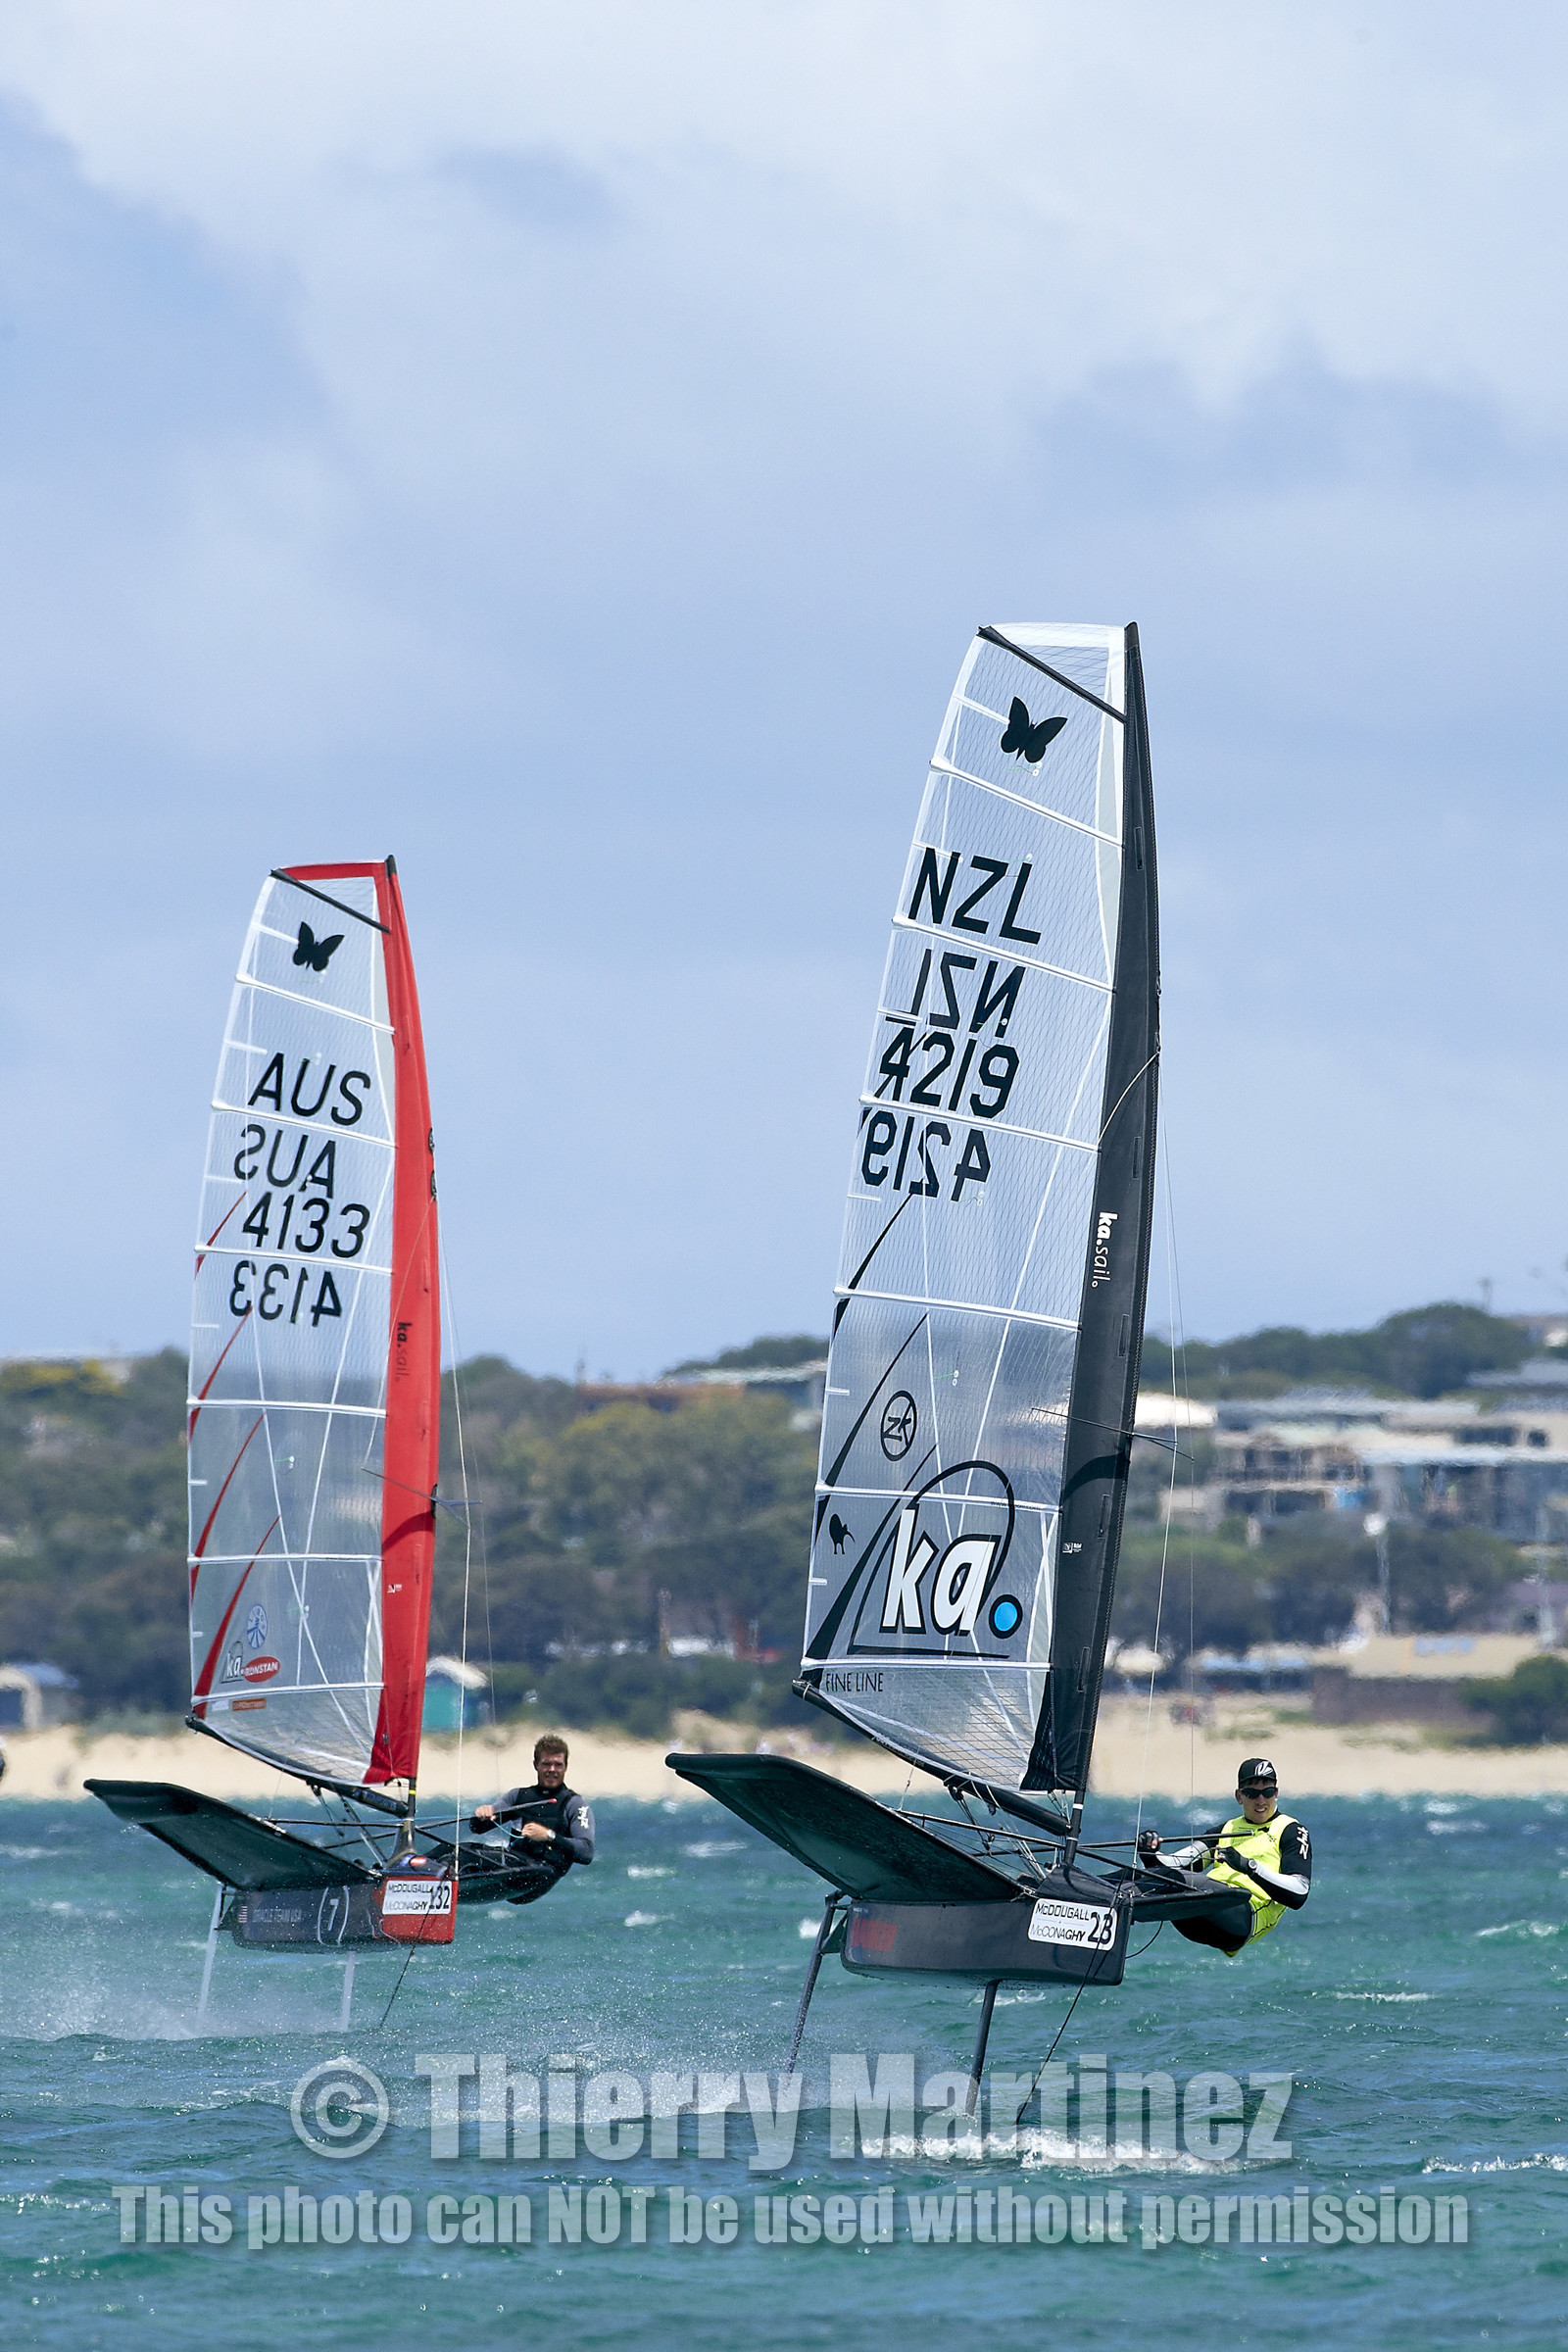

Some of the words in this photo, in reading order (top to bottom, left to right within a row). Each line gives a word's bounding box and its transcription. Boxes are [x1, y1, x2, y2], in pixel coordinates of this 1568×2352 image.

[907, 847, 1042, 945] NZL
[248, 1052, 371, 1127] AUS
[878, 1026, 1020, 1120] 4219
[242, 1191, 370, 1259] 4133
[825, 1672, 853, 1692] FINE
[856, 1672, 884, 1692] LINE
[1035, 1902, 1090, 1921] McDOUGALL
